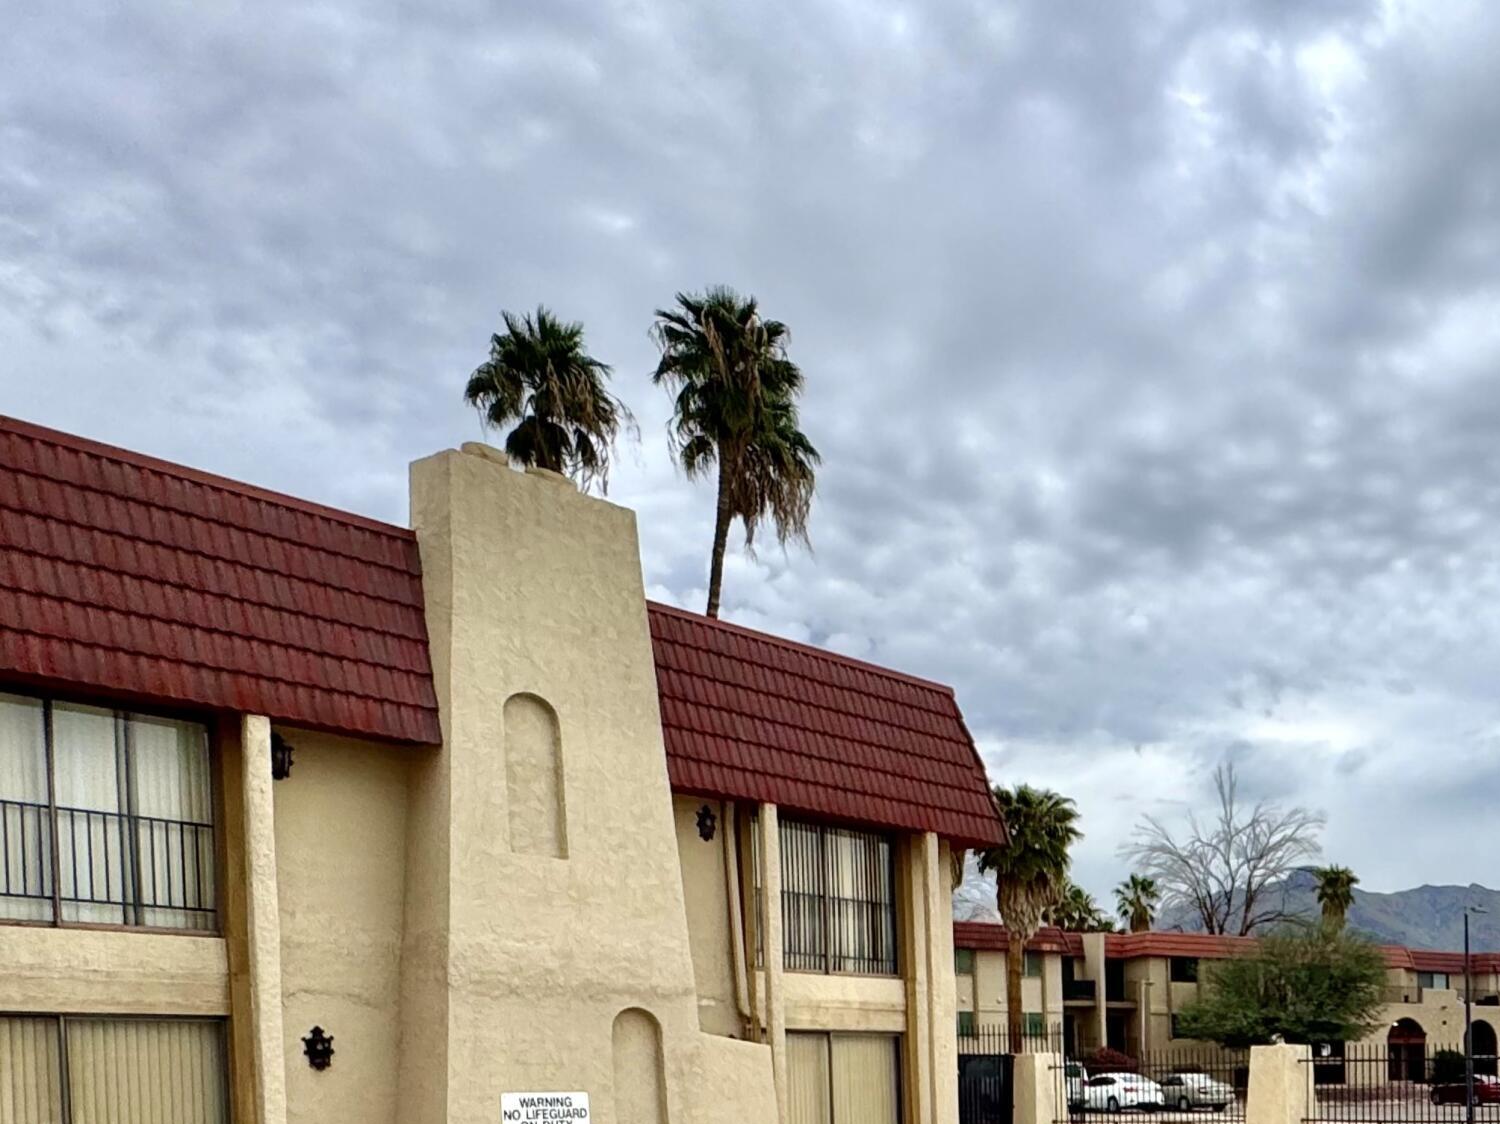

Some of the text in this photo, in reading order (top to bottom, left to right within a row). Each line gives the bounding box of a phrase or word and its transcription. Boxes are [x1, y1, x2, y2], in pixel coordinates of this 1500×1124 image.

[519, 1096, 573, 1108] WARNING
[503, 1107, 587, 1121] NO LIFEGUARD
